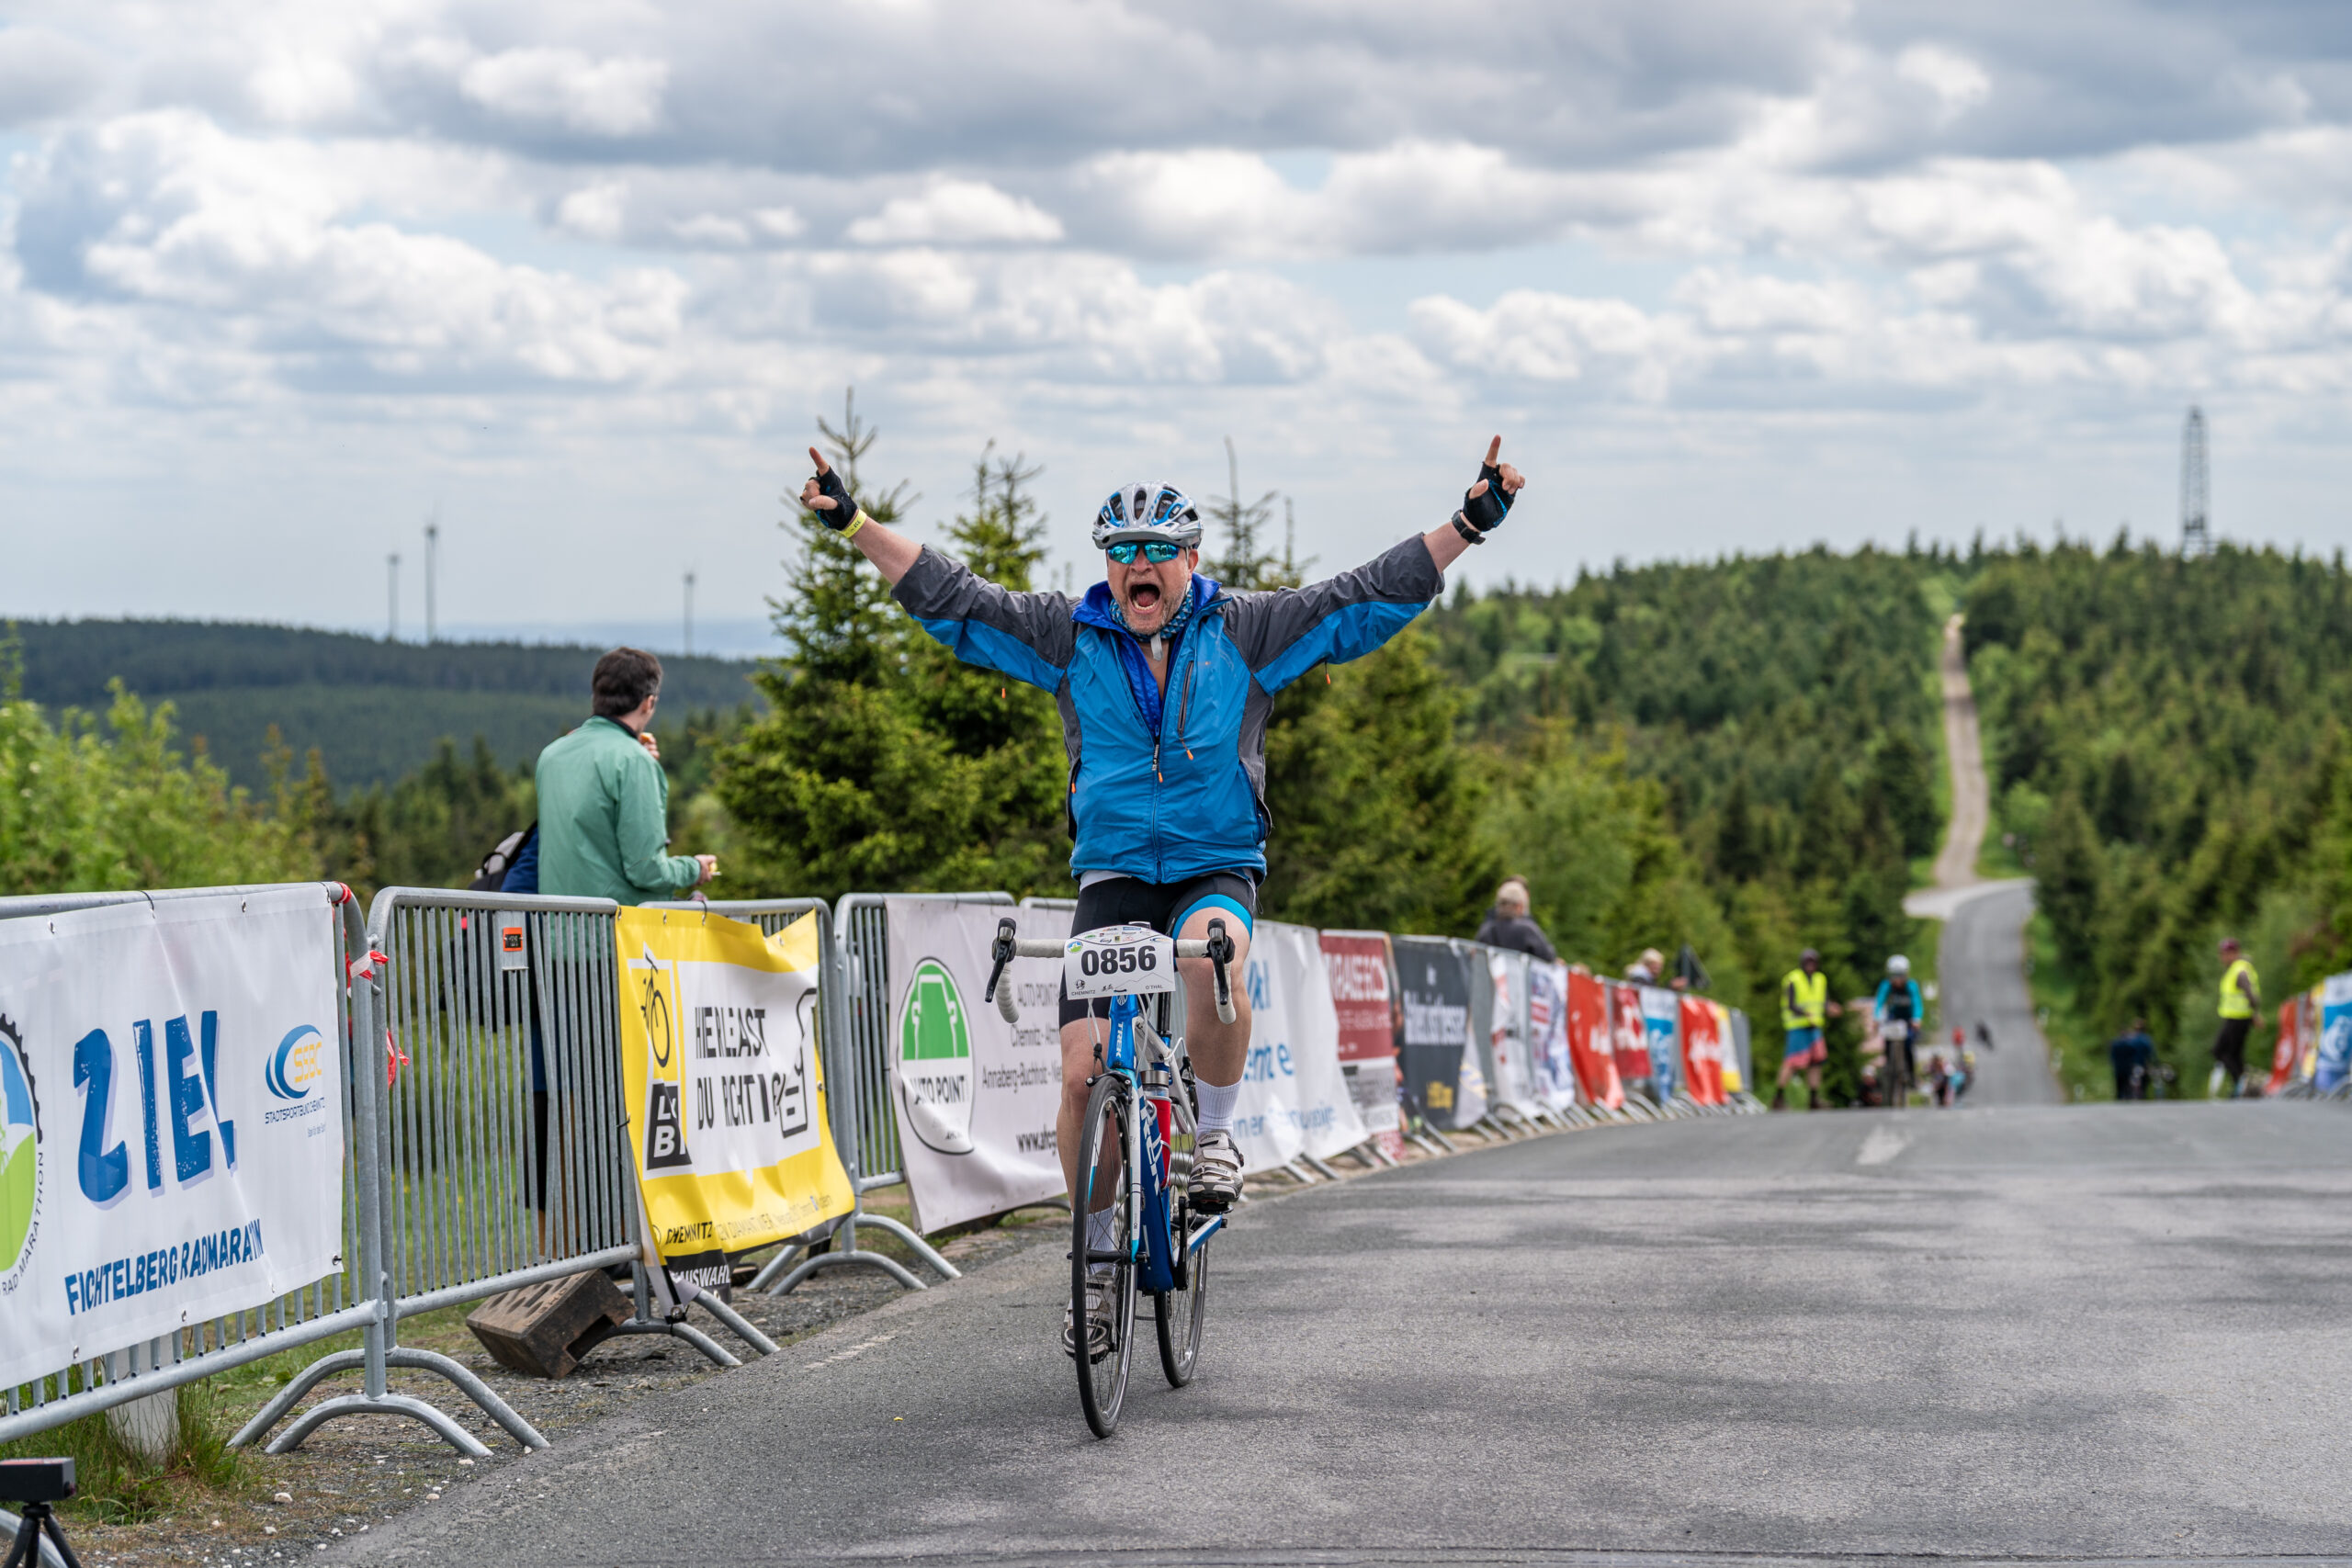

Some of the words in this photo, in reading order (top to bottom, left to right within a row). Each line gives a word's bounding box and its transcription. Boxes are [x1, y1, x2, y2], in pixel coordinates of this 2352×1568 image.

[1080, 945, 1157, 976] 0856
[1115, 1021, 1125, 1059] TREK
[697, 1076, 714, 1130] DU
[19, 1152, 43, 1277] MARATHON
[64, 1246, 178, 1316] FICHTELBERG
